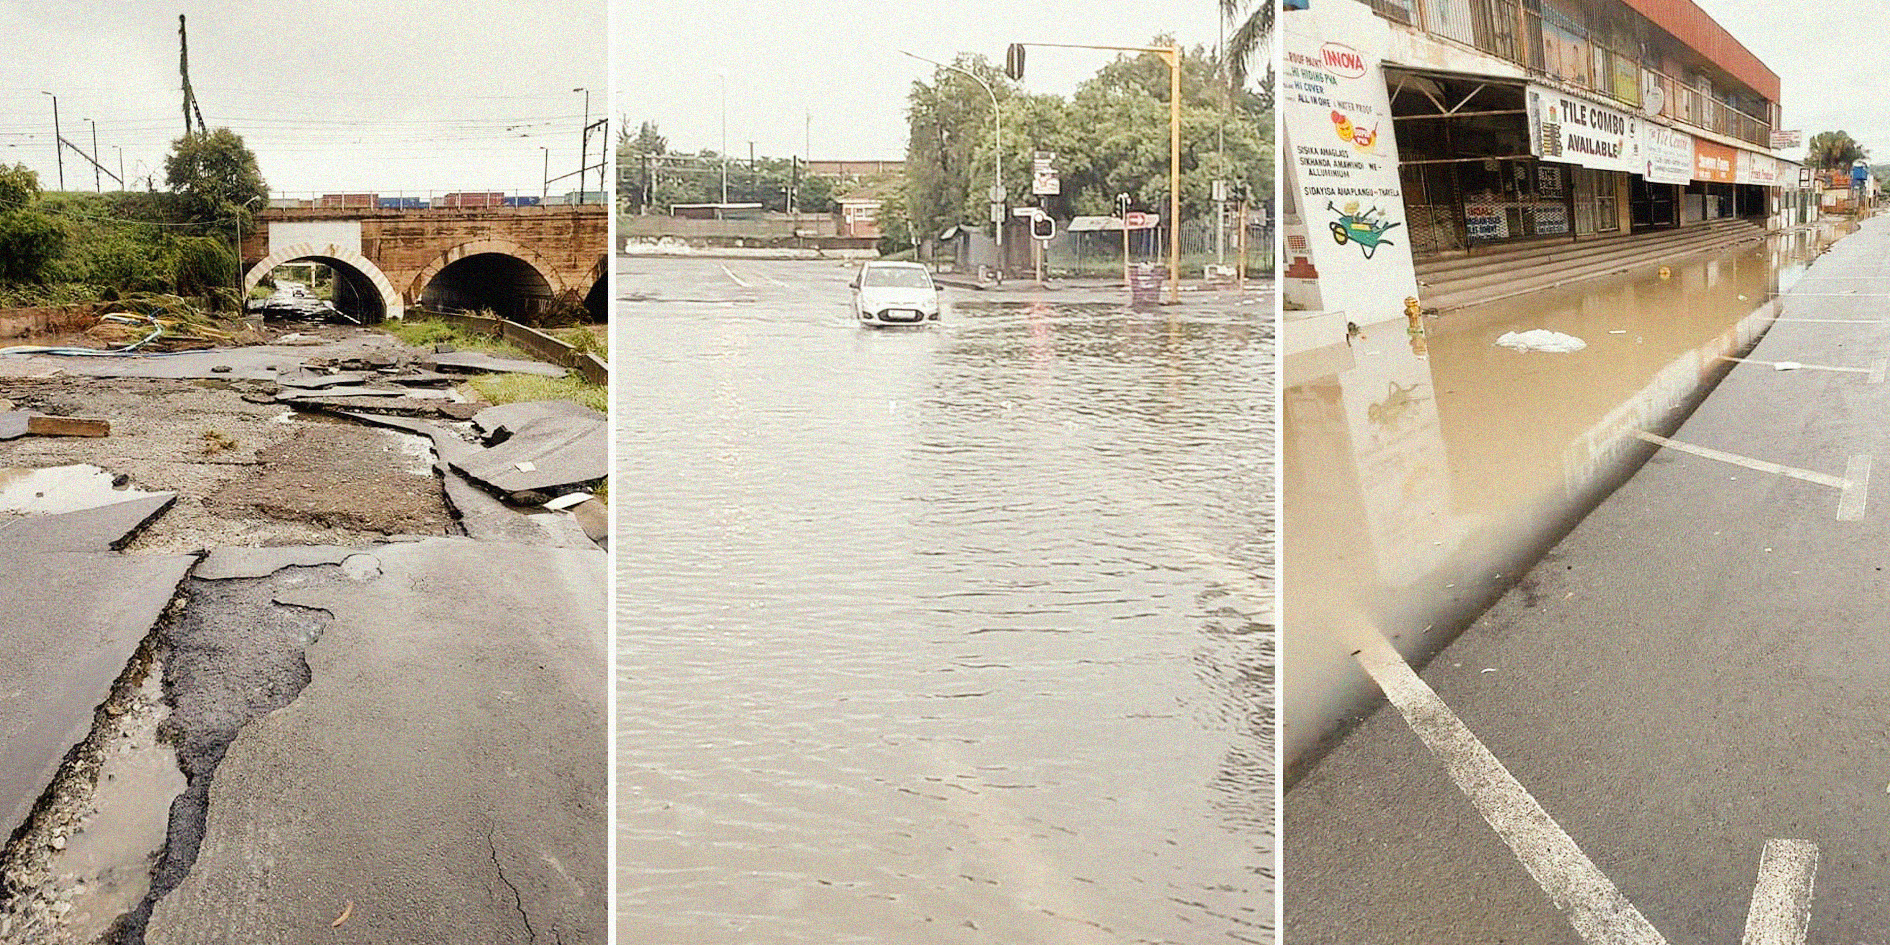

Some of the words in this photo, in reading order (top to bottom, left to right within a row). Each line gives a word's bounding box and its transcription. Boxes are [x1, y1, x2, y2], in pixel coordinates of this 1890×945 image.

[1322, 48, 1364, 71] INNOVA
[1560, 98, 1588, 126] TILE
[1589, 107, 1625, 136] COMBO
[1567, 133, 1618, 159] AVAILABLE
